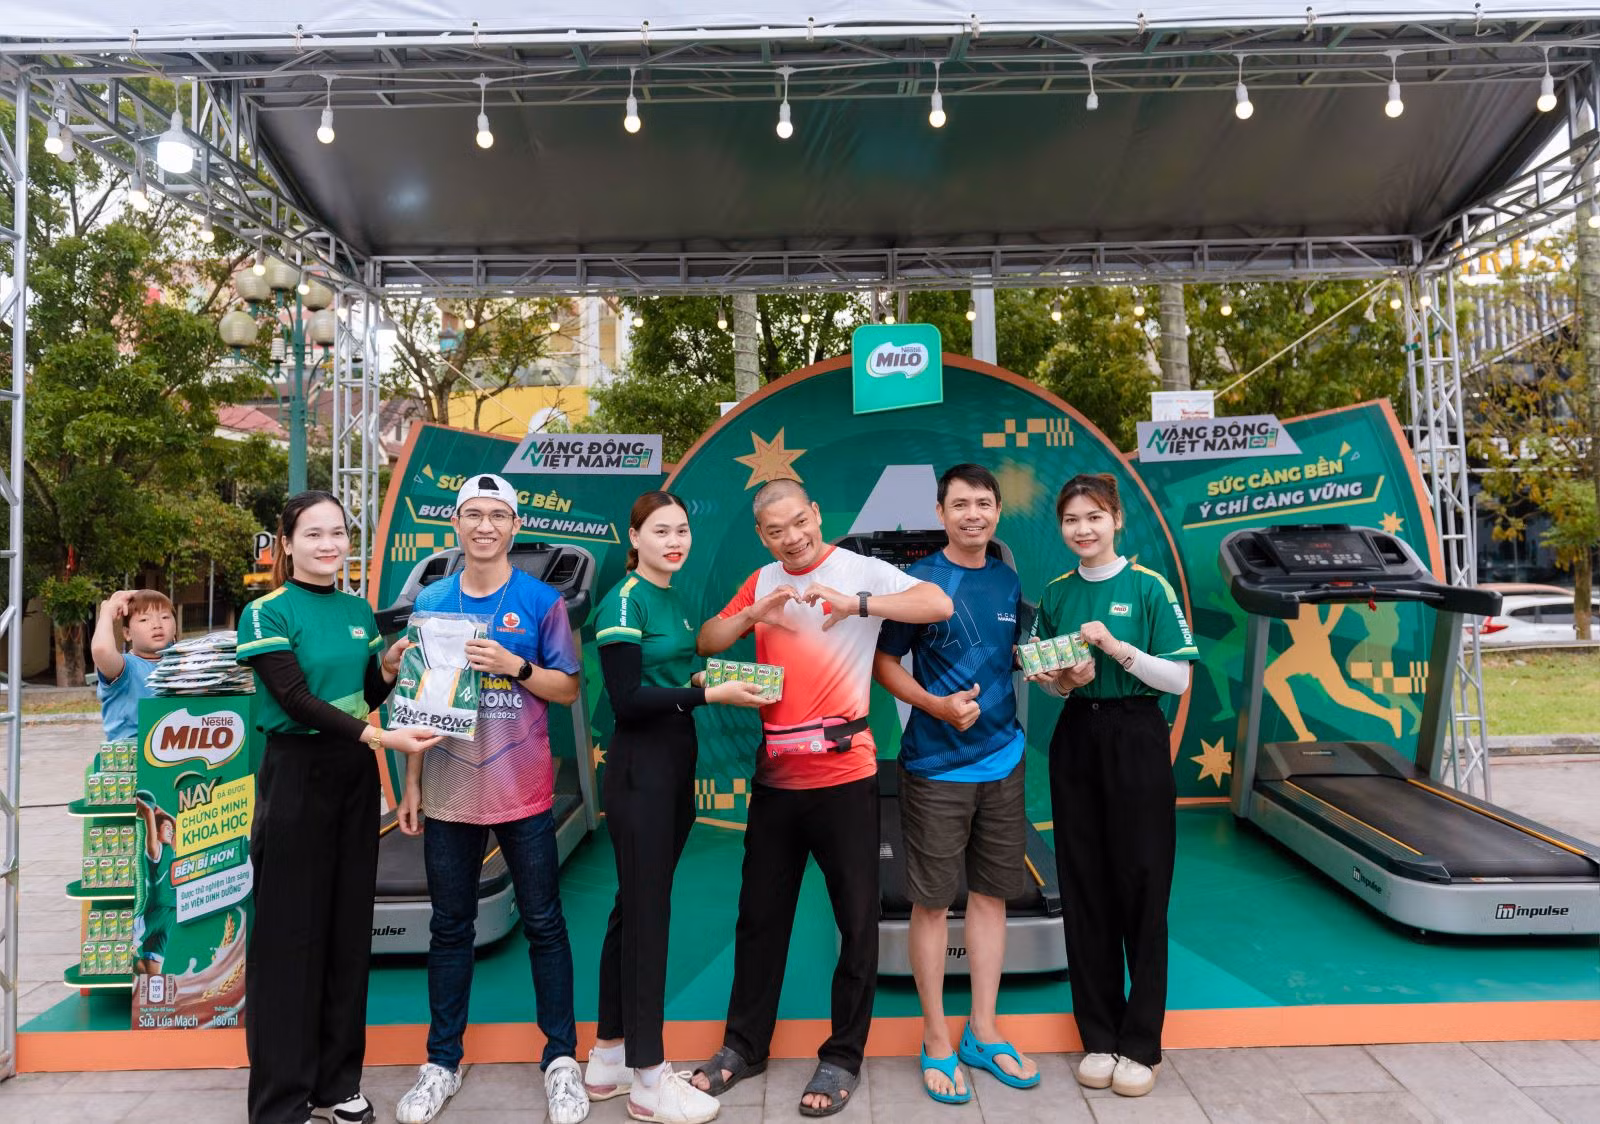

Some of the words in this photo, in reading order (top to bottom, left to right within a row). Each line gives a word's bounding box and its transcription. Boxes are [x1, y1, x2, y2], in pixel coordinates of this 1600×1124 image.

[876, 352, 922, 367] MILO
[1146, 425, 1207, 448] NĂNG
[1155, 436, 1200, 456] VIỆT
[1203, 437, 1248, 452] NAM
[521, 438, 584, 460] NĂNG
[530, 451, 575, 469] VIỆT
[577, 455, 622, 468] NAM
[1207, 475, 1246, 497] SỨC
[1247, 466, 1302, 489] CÀNG
[1304, 456, 1344, 479] BỀN
[436, 474, 466, 492] SỨ
[532, 490, 572, 513] BỀN
[1200, 501, 1213, 519] Ý
[1215, 496, 1249, 516] CHÍ
[1252, 490, 1305, 511] CÀNG
[1309, 482, 1363, 501] VỮNG
[418, 504, 457, 519] BƯỚ
[520, 513, 551, 529] ÀNG
[551, 519, 609, 536] NHANH
[201, 716, 234, 727] Nestlé
[497, 711, 517, 720] 2025
[160, 725, 235, 751] MILO
[177, 778, 218, 813] NAY
[181, 806, 219, 829] CHỨNG
[221, 797, 248, 816] MINH
[182, 822, 219, 847] KHOA
[221, 811, 248, 834] HỌC
[209, 847, 235, 866] HƠN
[205, 891, 221, 904] DINH
[1516, 904, 1570, 919] impulse
[371, 925, 407, 936] pulse
[138, 1013, 155, 1028] Sữa
[157, 1013, 173, 1027] Lúa
[174, 1014, 199, 1031] Mạch
[227, 1014, 239, 1027] ml
